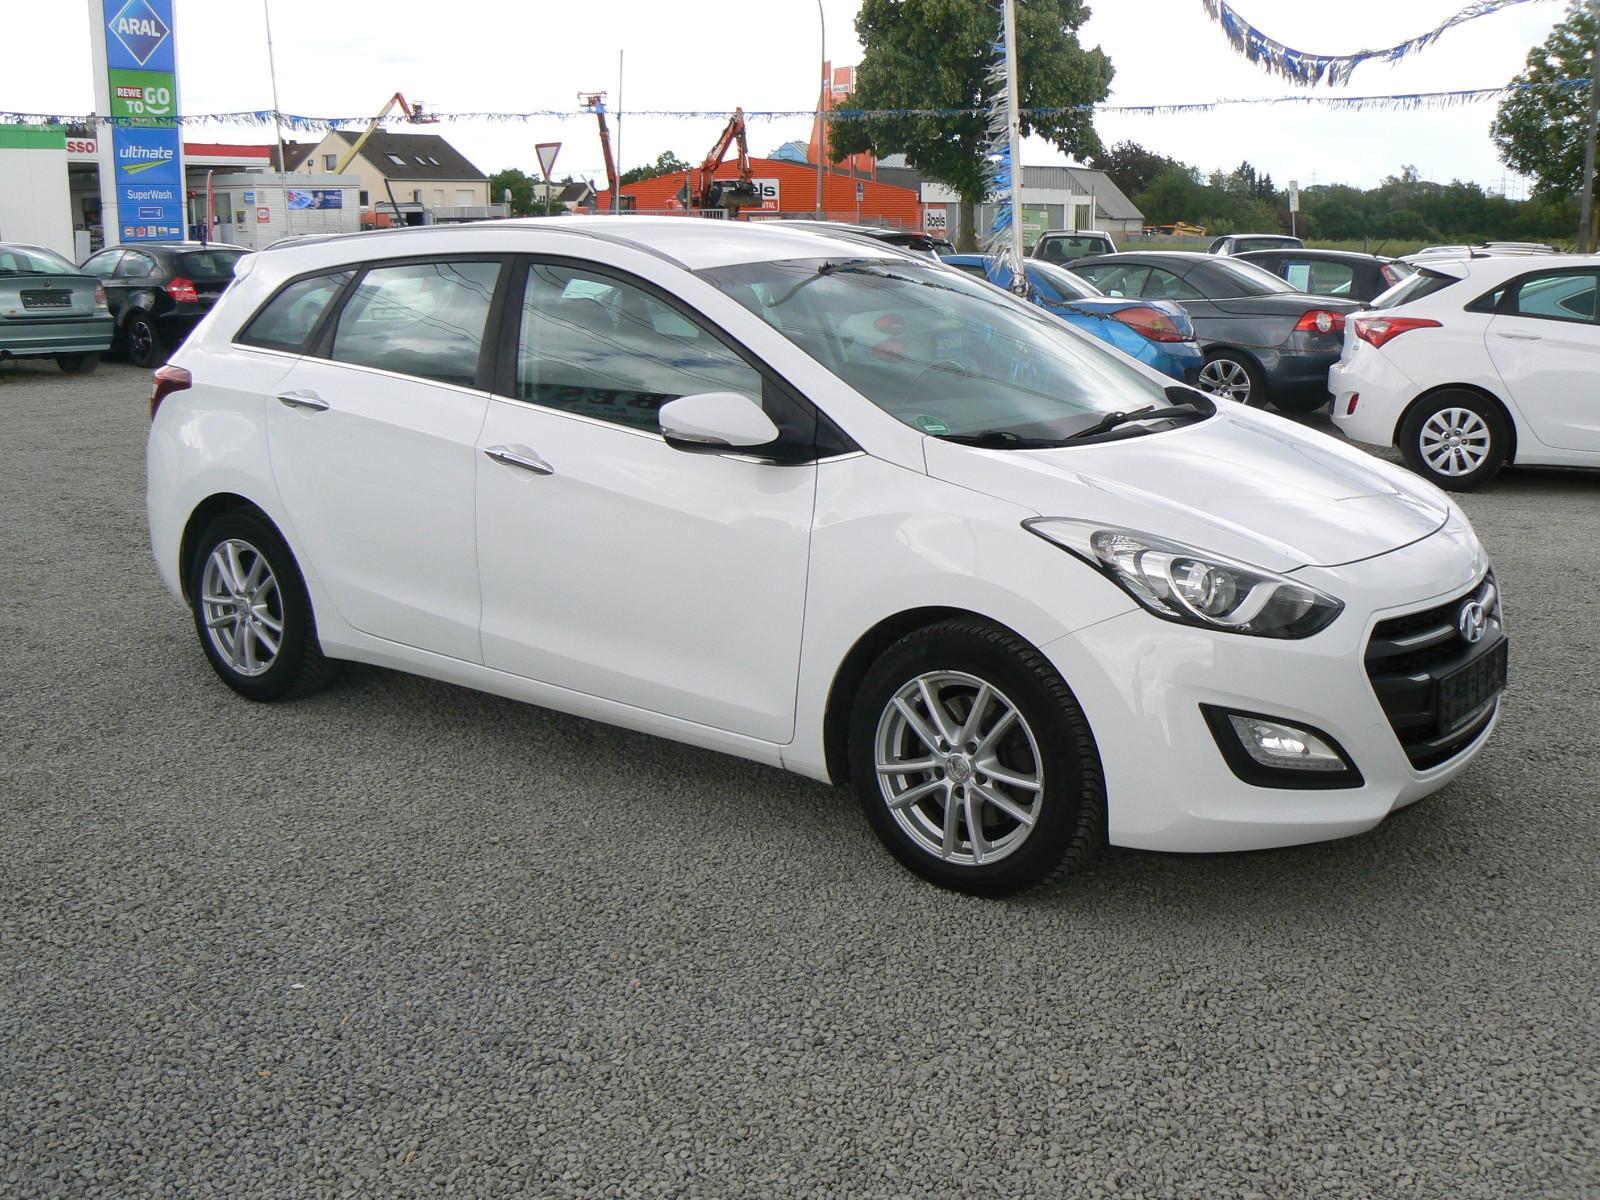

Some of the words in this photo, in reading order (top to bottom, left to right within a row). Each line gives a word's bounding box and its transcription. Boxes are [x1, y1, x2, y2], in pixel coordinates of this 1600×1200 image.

[117, 17, 161, 37] ARAL
[117, 87, 142, 98] REWE
[144, 87, 170, 105] GO
[126, 100, 144, 113] TO
[120, 145, 174, 159] ultimate
[127, 189, 173, 200] SuperWash
[926, 212, 946, 227] Boels
